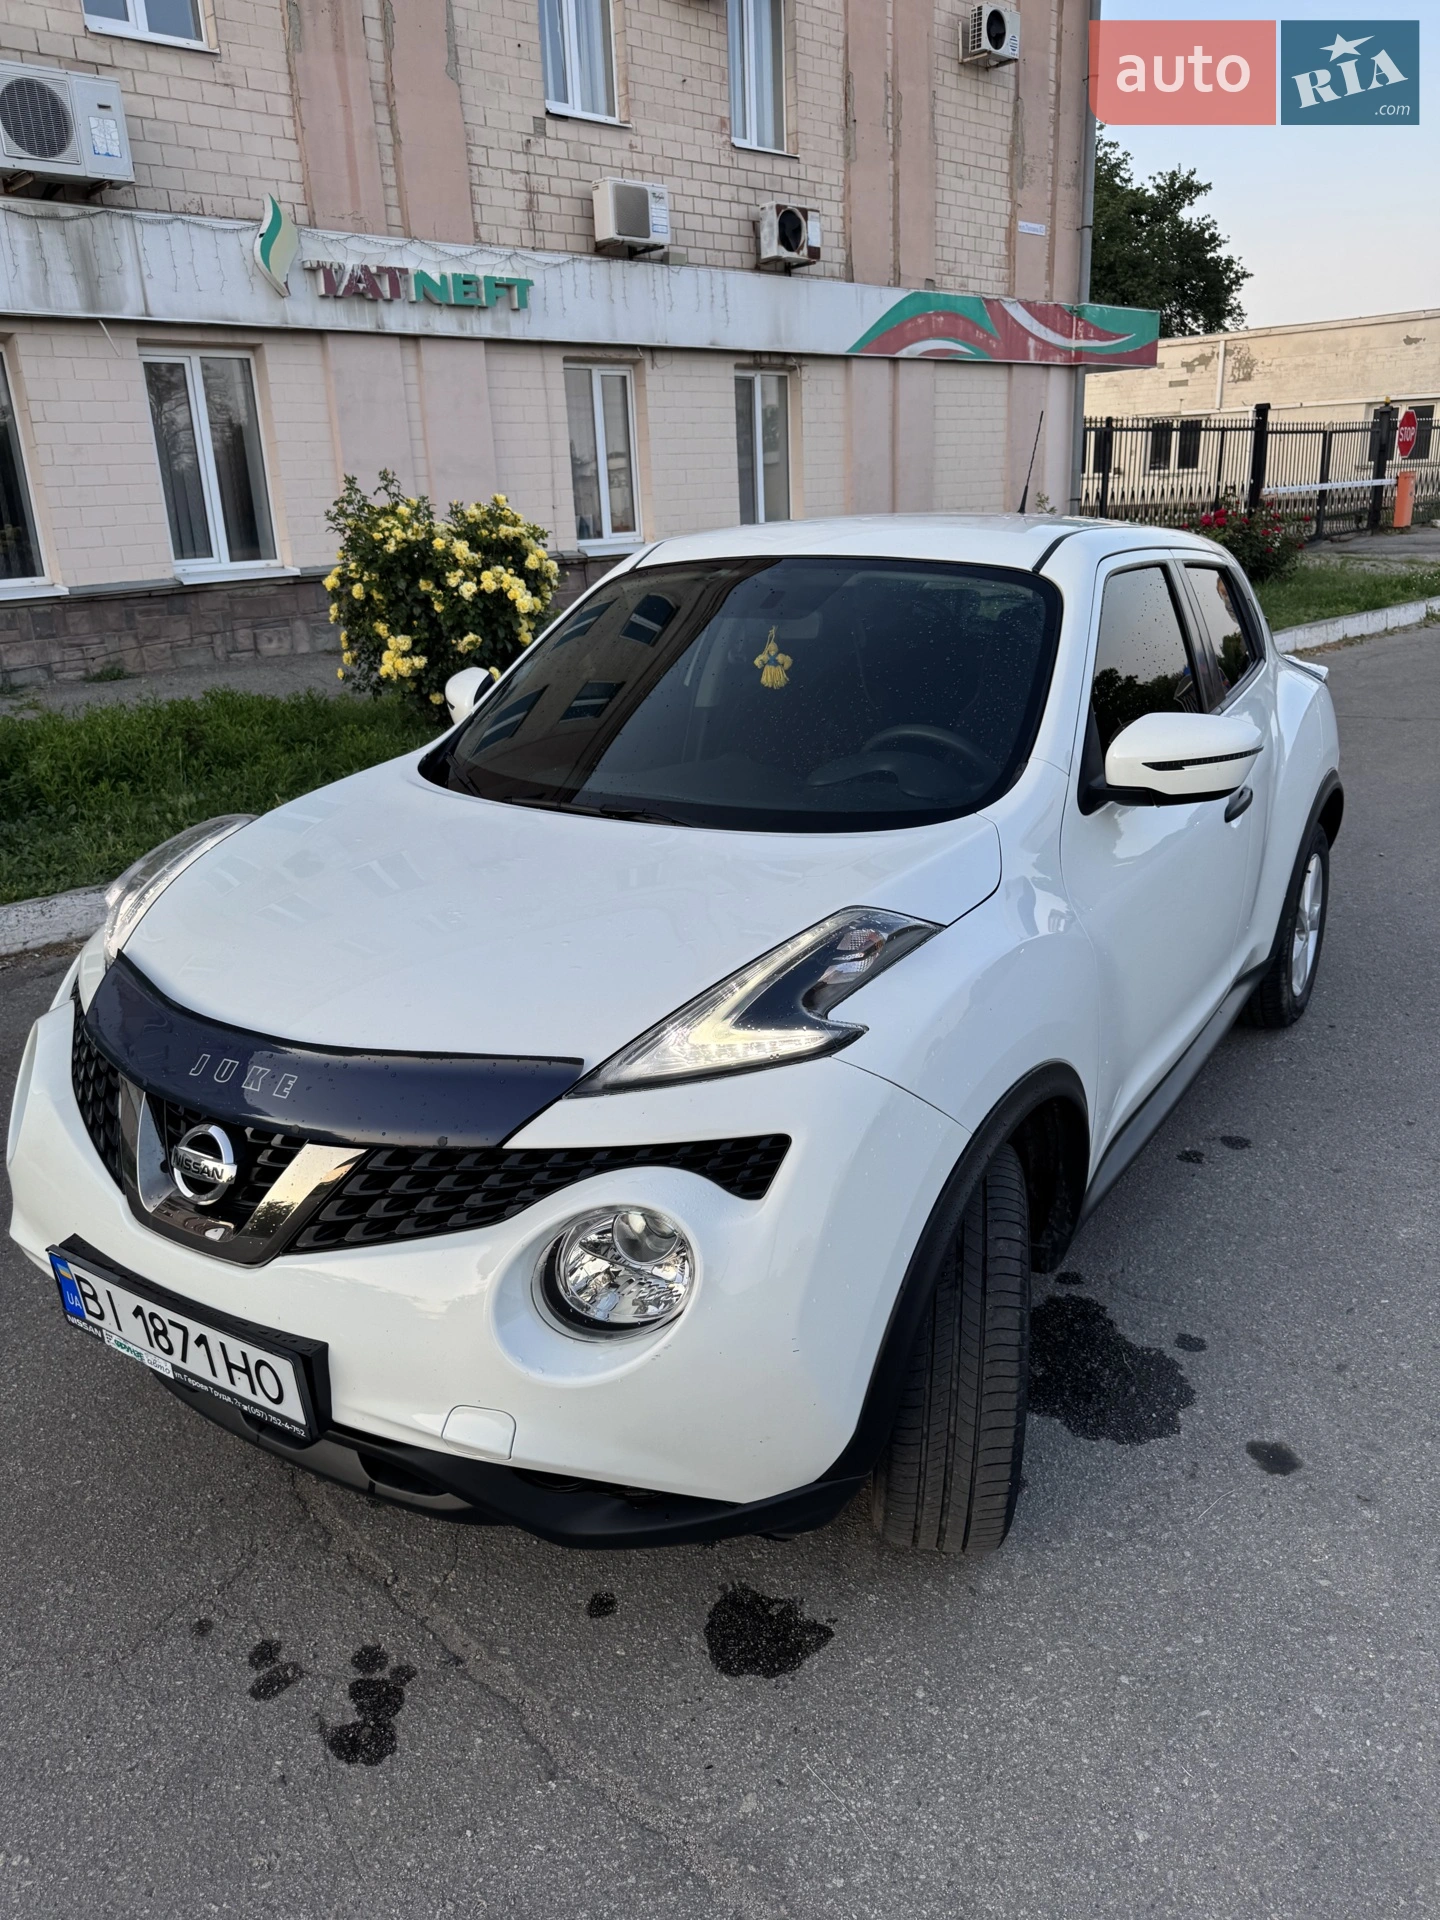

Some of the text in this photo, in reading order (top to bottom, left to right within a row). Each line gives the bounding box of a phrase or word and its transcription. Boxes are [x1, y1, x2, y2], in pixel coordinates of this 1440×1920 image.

[303, 259, 534, 310] TATNEFT
[1399, 426, 1416, 442] STOP
[189, 1053, 298, 1099] JUKE
[173, 1153, 225, 1180] NISSAN
[67, 1291, 82, 1309] UA
[67, 1314, 102, 1338] NISSAN
